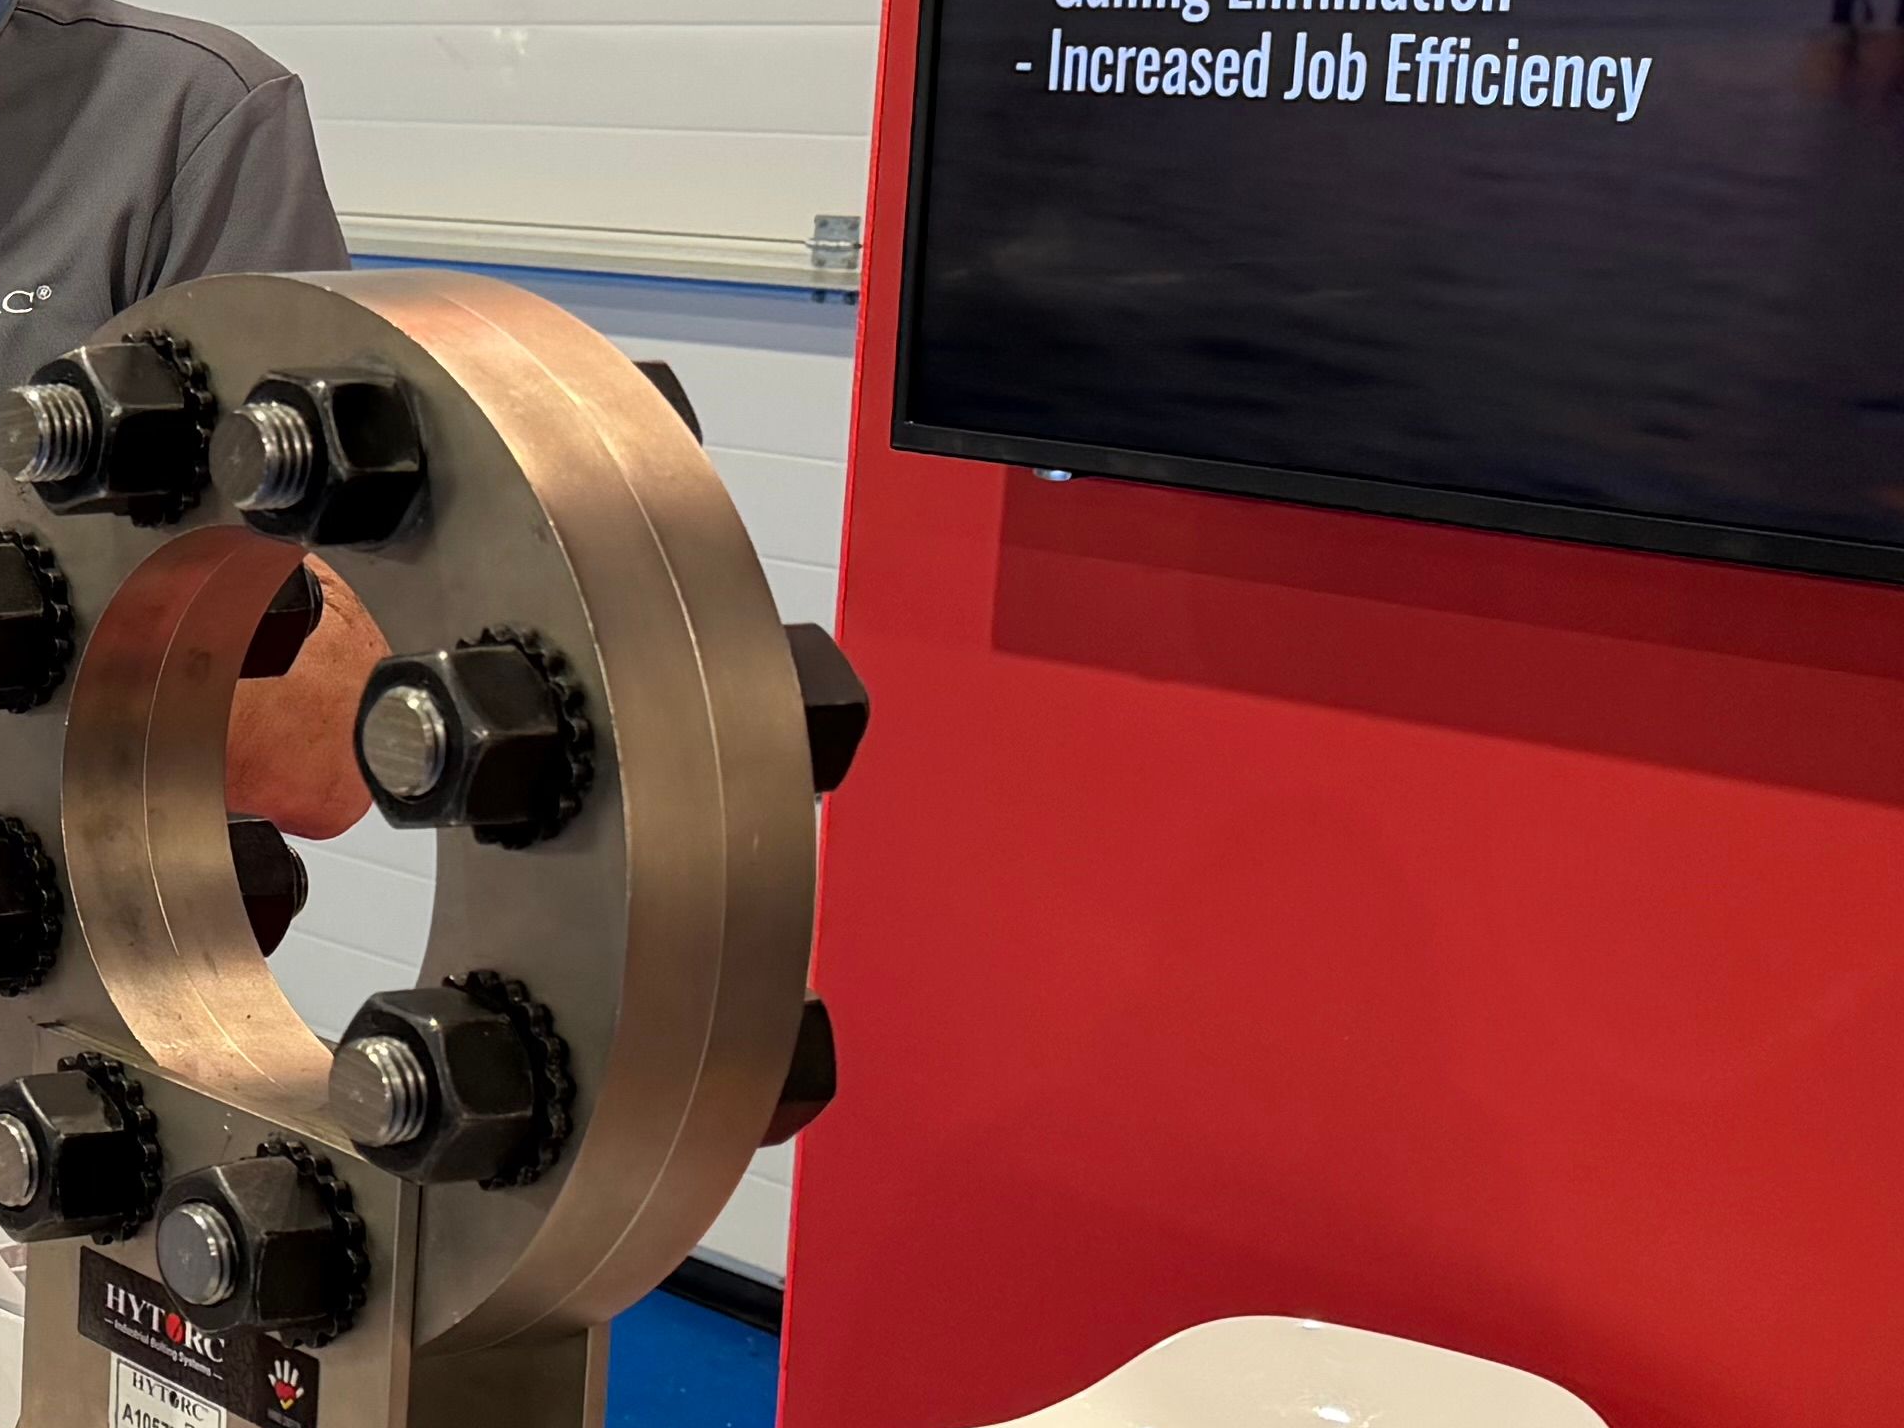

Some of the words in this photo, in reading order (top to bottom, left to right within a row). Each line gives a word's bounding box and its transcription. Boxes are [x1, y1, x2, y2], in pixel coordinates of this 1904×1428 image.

[1047, 27, 1273, 97] Increased
[1282, 30, 1368, 102] Job
[1384, 31, 1653, 123] Efficiency
[105, 1282, 226, 1363] HYTORC
[132, 1371, 206, 1422] HYTORC
